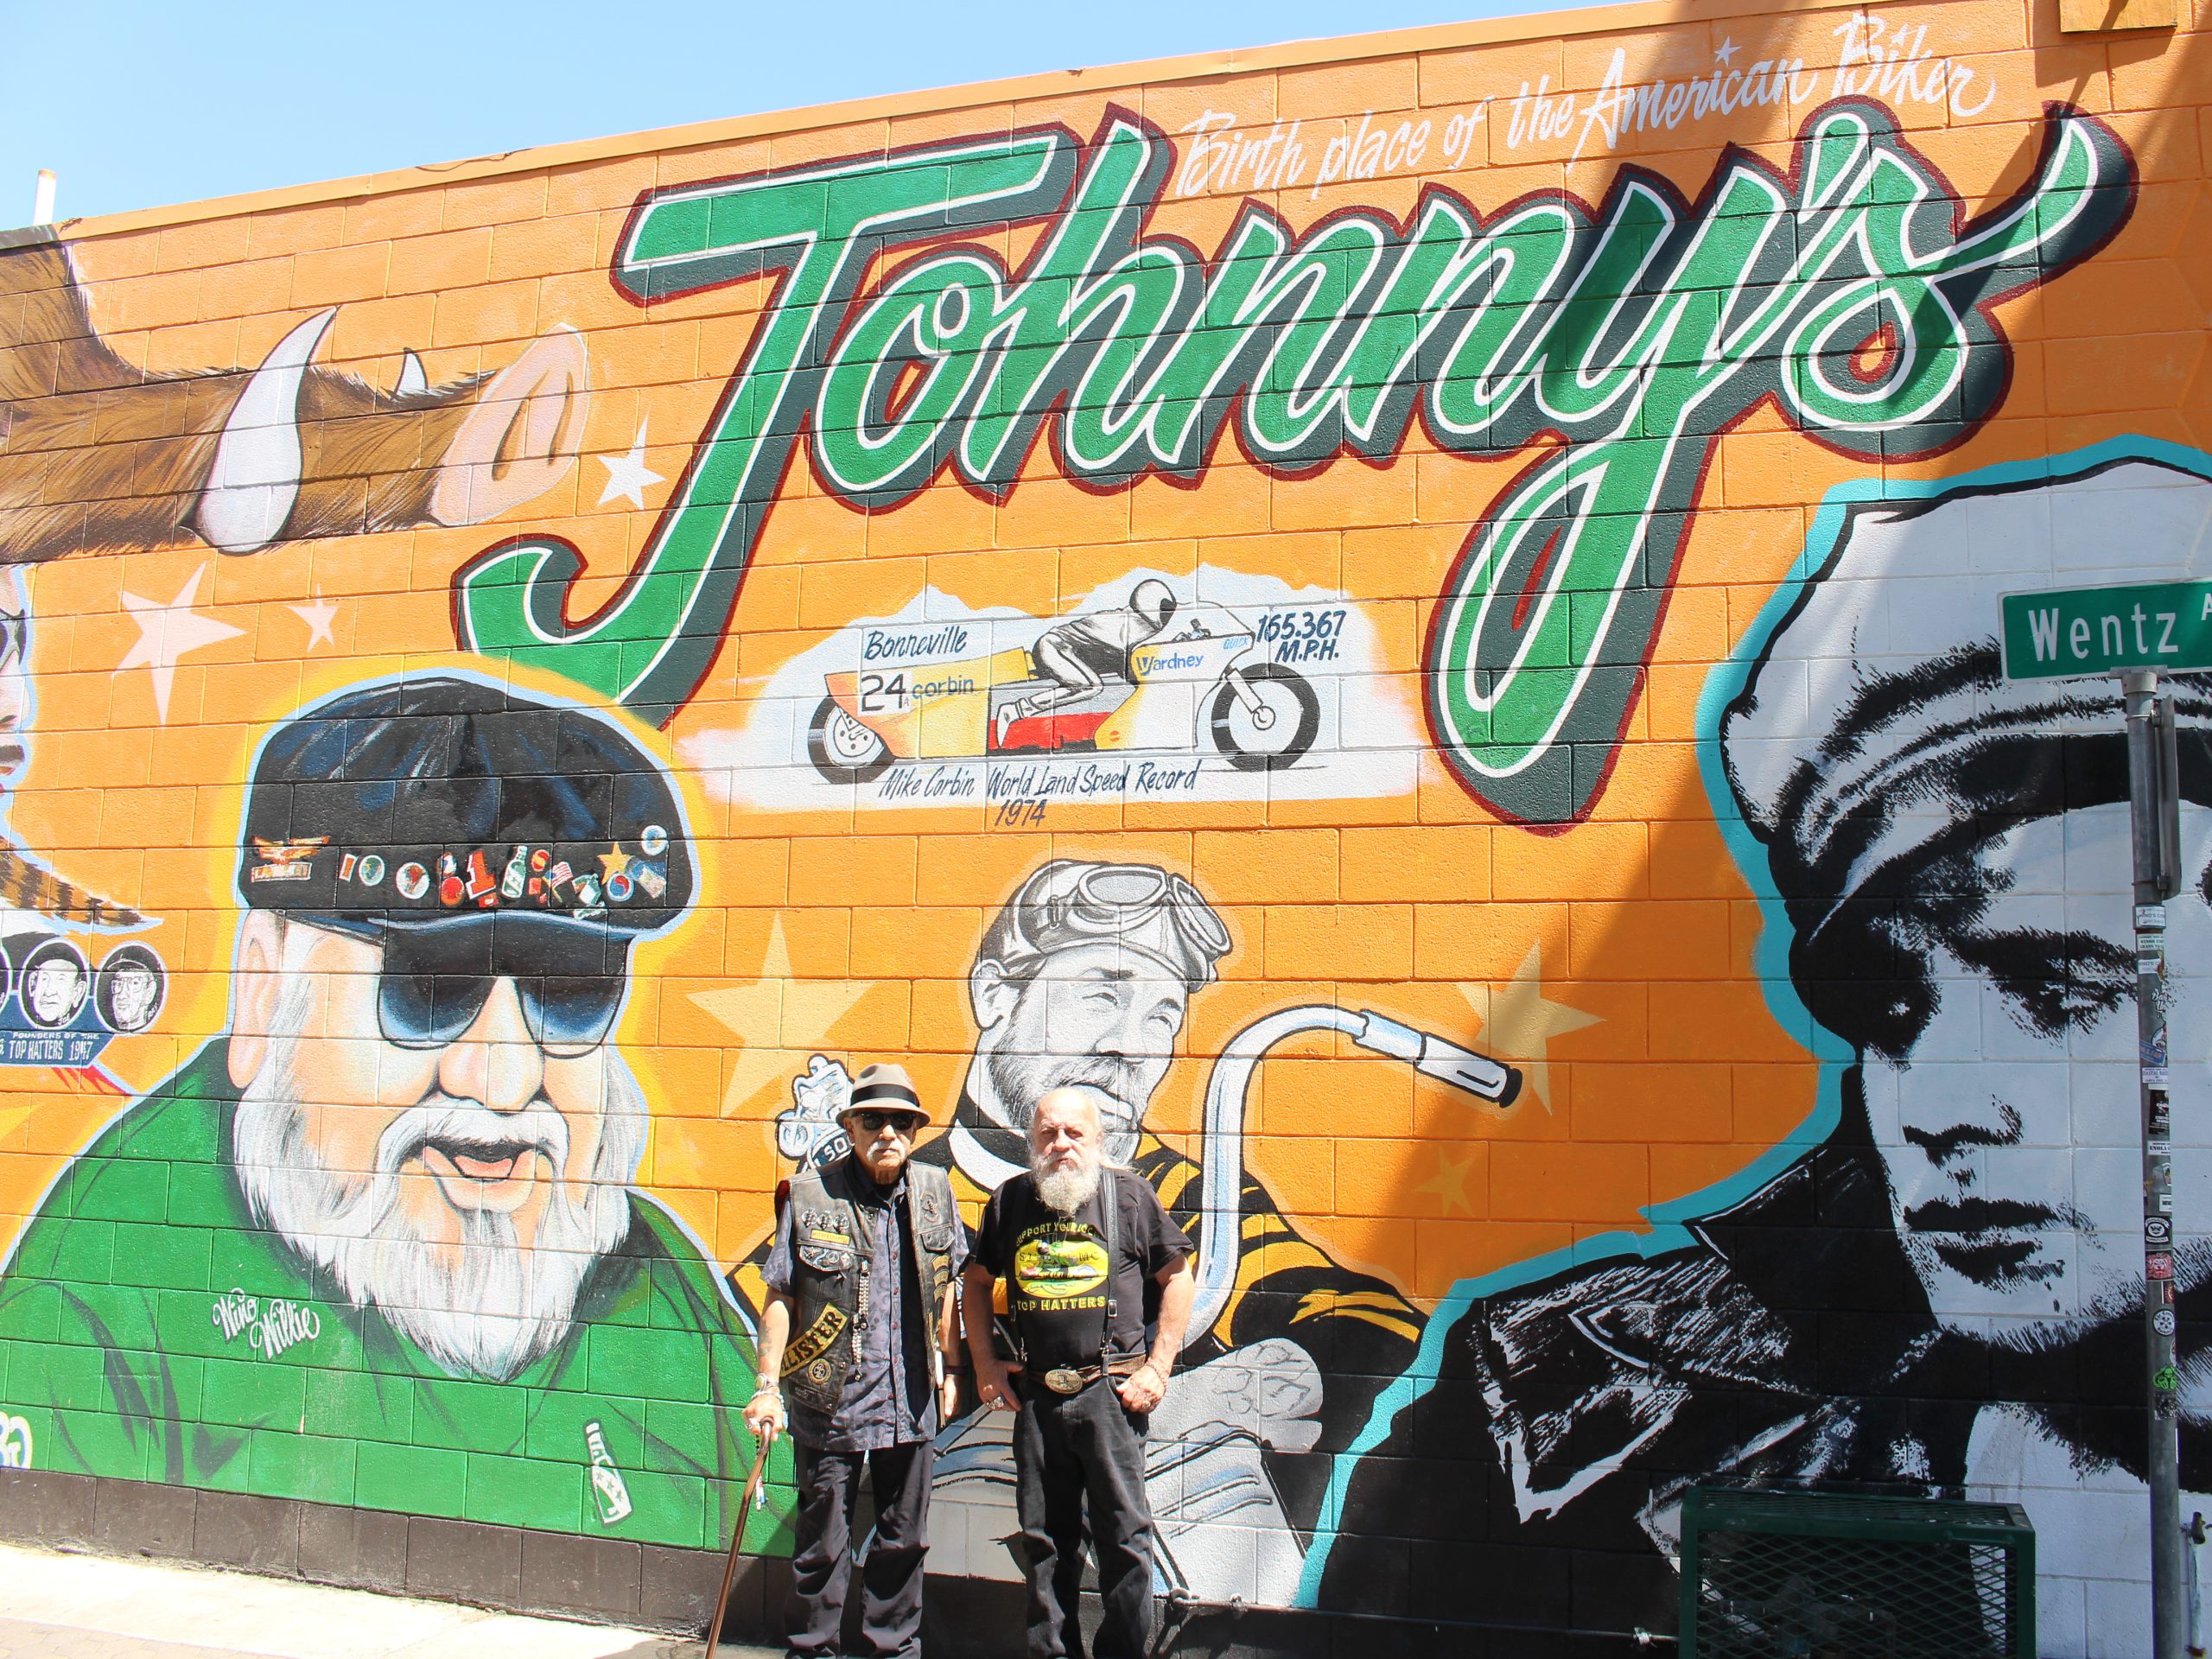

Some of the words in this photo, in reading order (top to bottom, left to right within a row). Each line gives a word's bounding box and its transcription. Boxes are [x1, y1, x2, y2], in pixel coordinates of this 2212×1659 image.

[1175, 109, 1309, 197] Birth
[1311, 110, 1431, 200] place
[1442, 95, 1495, 170] of
[1507, 74, 1575, 149] the
[1566, 37, 1819, 176] American
[1832, 11, 1997, 117] Biker
[453, 102, 2138, 836] Johnny's
[864, 625, 969, 660] Bonneville
[1256, 610, 1347, 643] 165.367
[2027, 601, 2179, 662] Wentz
[1274, 638, 1339, 663] M.P.H.
[861, 673, 907, 712] 24
[912, 675, 975, 699] corbin
[878, 766, 922, 800] Mike
[924, 766, 976, 798] Corbin
[987, 764, 1036, 800] World
[1033, 766, 1081, 797] Land
[1079, 764, 1131, 797] Speed
[1135, 759, 1203, 794] Record
[995, 798, 1048, 828] 1974
[9, 1039, 27, 1059] TOP
[28, 1039, 64, 1060] HATTERS
[68, 1040, 93, 1061] 1947
[1016, 1223, 1052, 1247] SUPPORT
[1017, 1300, 1037, 1311] TOP
[1040, 1295, 1106, 1312] HATTERS
